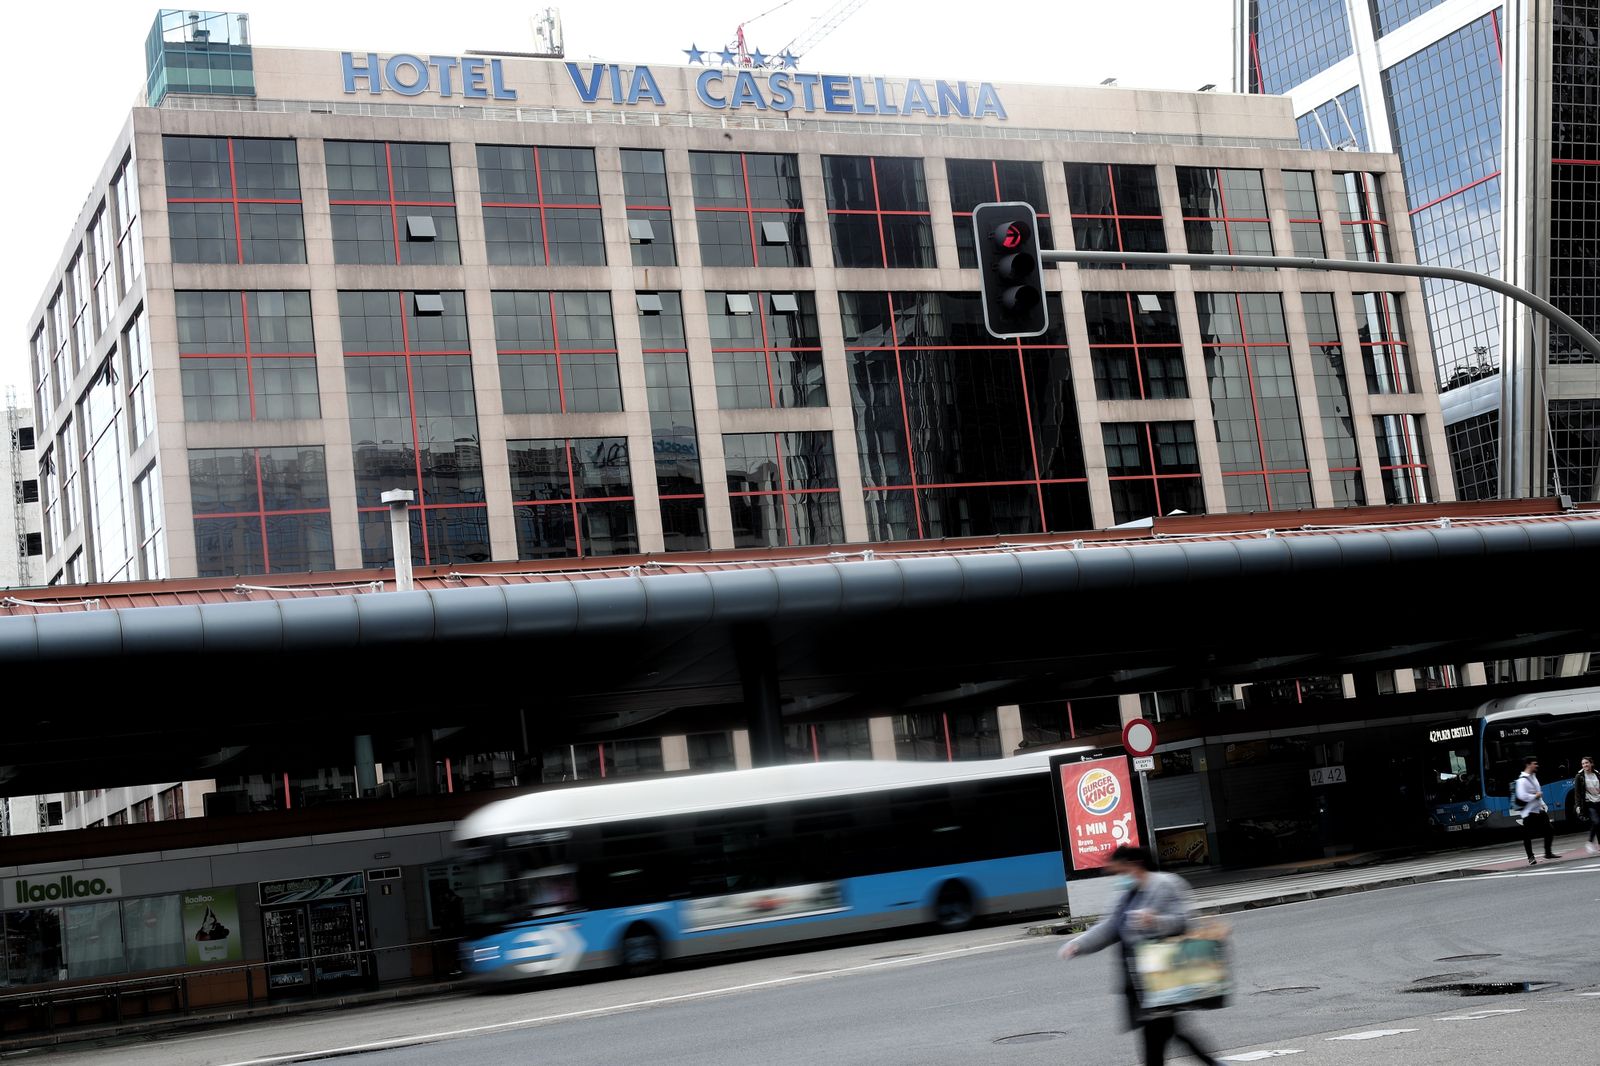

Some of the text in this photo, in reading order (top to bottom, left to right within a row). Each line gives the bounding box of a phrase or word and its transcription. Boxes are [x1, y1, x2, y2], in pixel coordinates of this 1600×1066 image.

[340, 51, 1008, 121] HOTEL VIA CASTELLANA
[1328, 768, 1343, 781] 42
[1082, 776, 1113, 796] BURGER
[1085, 783, 1116, 806] KING
[1076, 821, 1107, 837] 1 MIN
[1077, 839, 1094, 847] Bravo
[1100, 843, 1111, 851] 377
